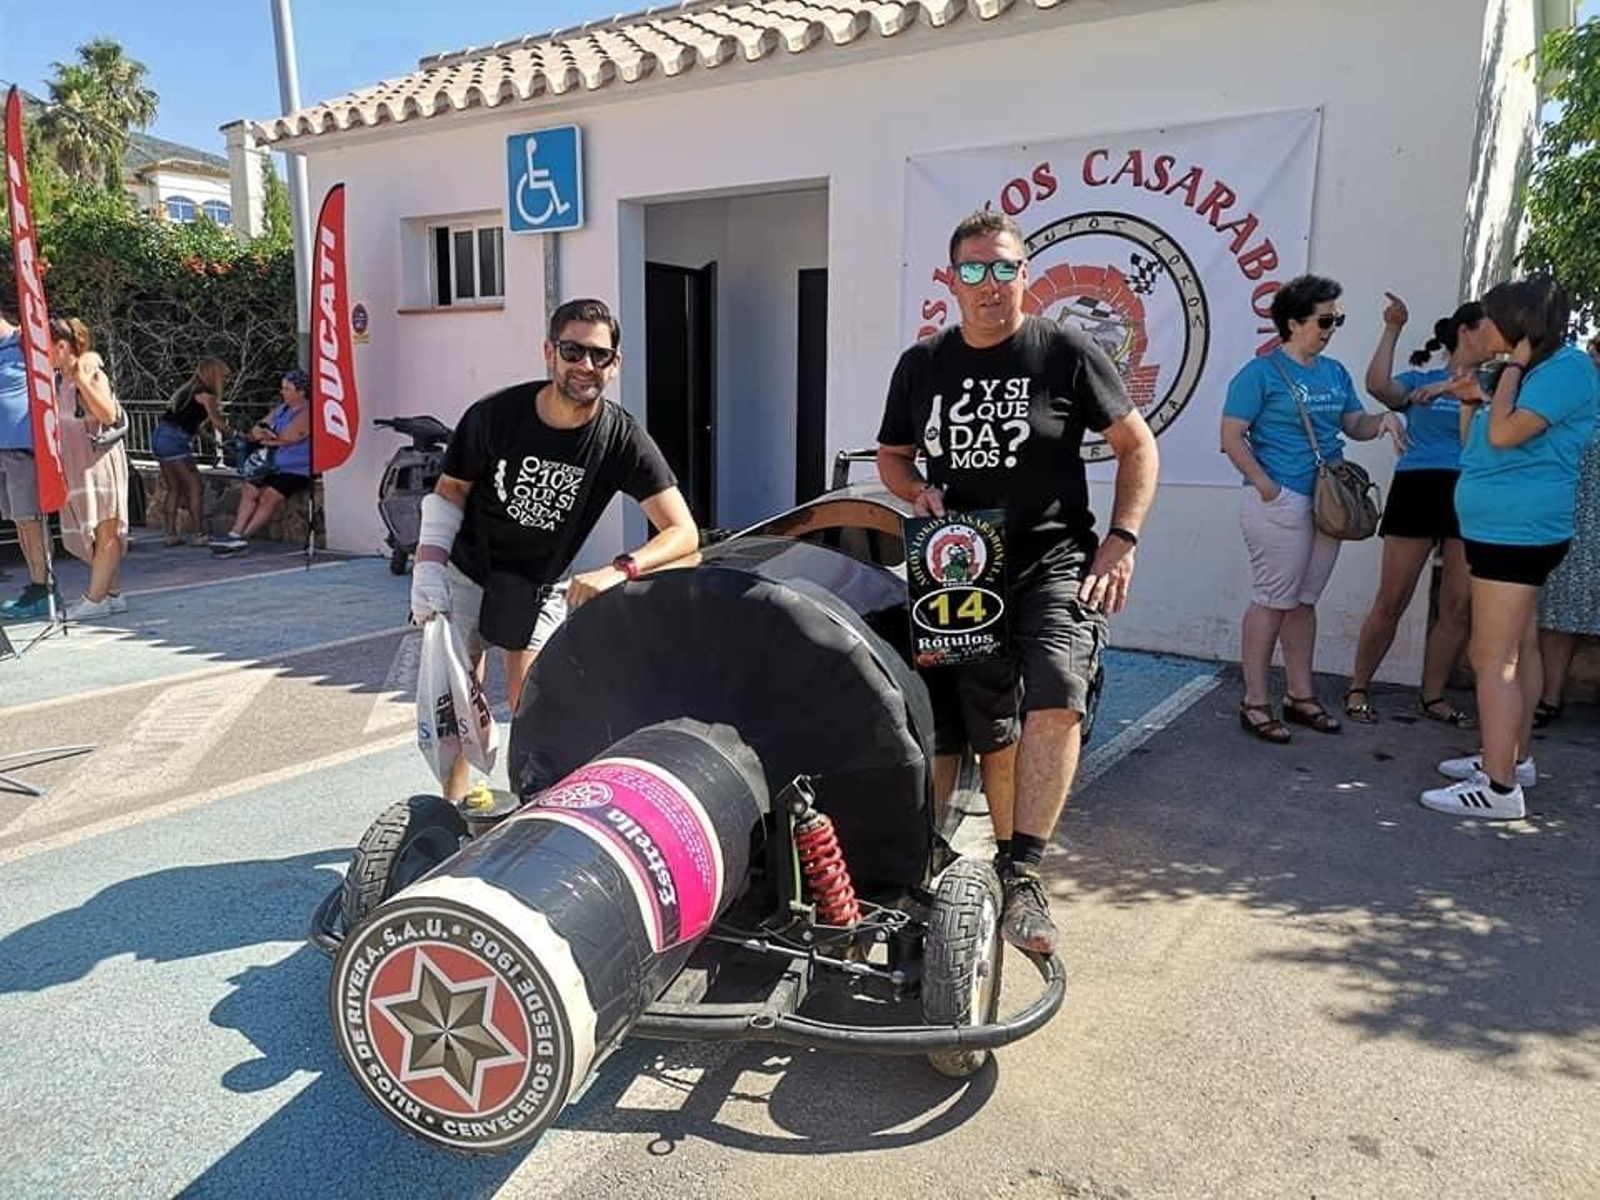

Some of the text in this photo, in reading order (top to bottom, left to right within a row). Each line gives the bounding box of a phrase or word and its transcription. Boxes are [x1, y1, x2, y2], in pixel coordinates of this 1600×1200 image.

[1151, 237, 1203, 329] LOKOS
[320, 225, 351, 443] DUCATI
[1004, 378, 1030, 400] SI
[976, 401, 1029, 422] QUE
[948, 422, 1000, 450] DA
[949, 449, 1001, 469] MOS
[537, 468, 583, 496] 10%
[928, 590, 987, 626] 14
[347, 918, 449, 1121] HIJOS DE RIVERA, S.A.U.
[442, 931, 555, 1138] CERVECEROS DESDE 1906
